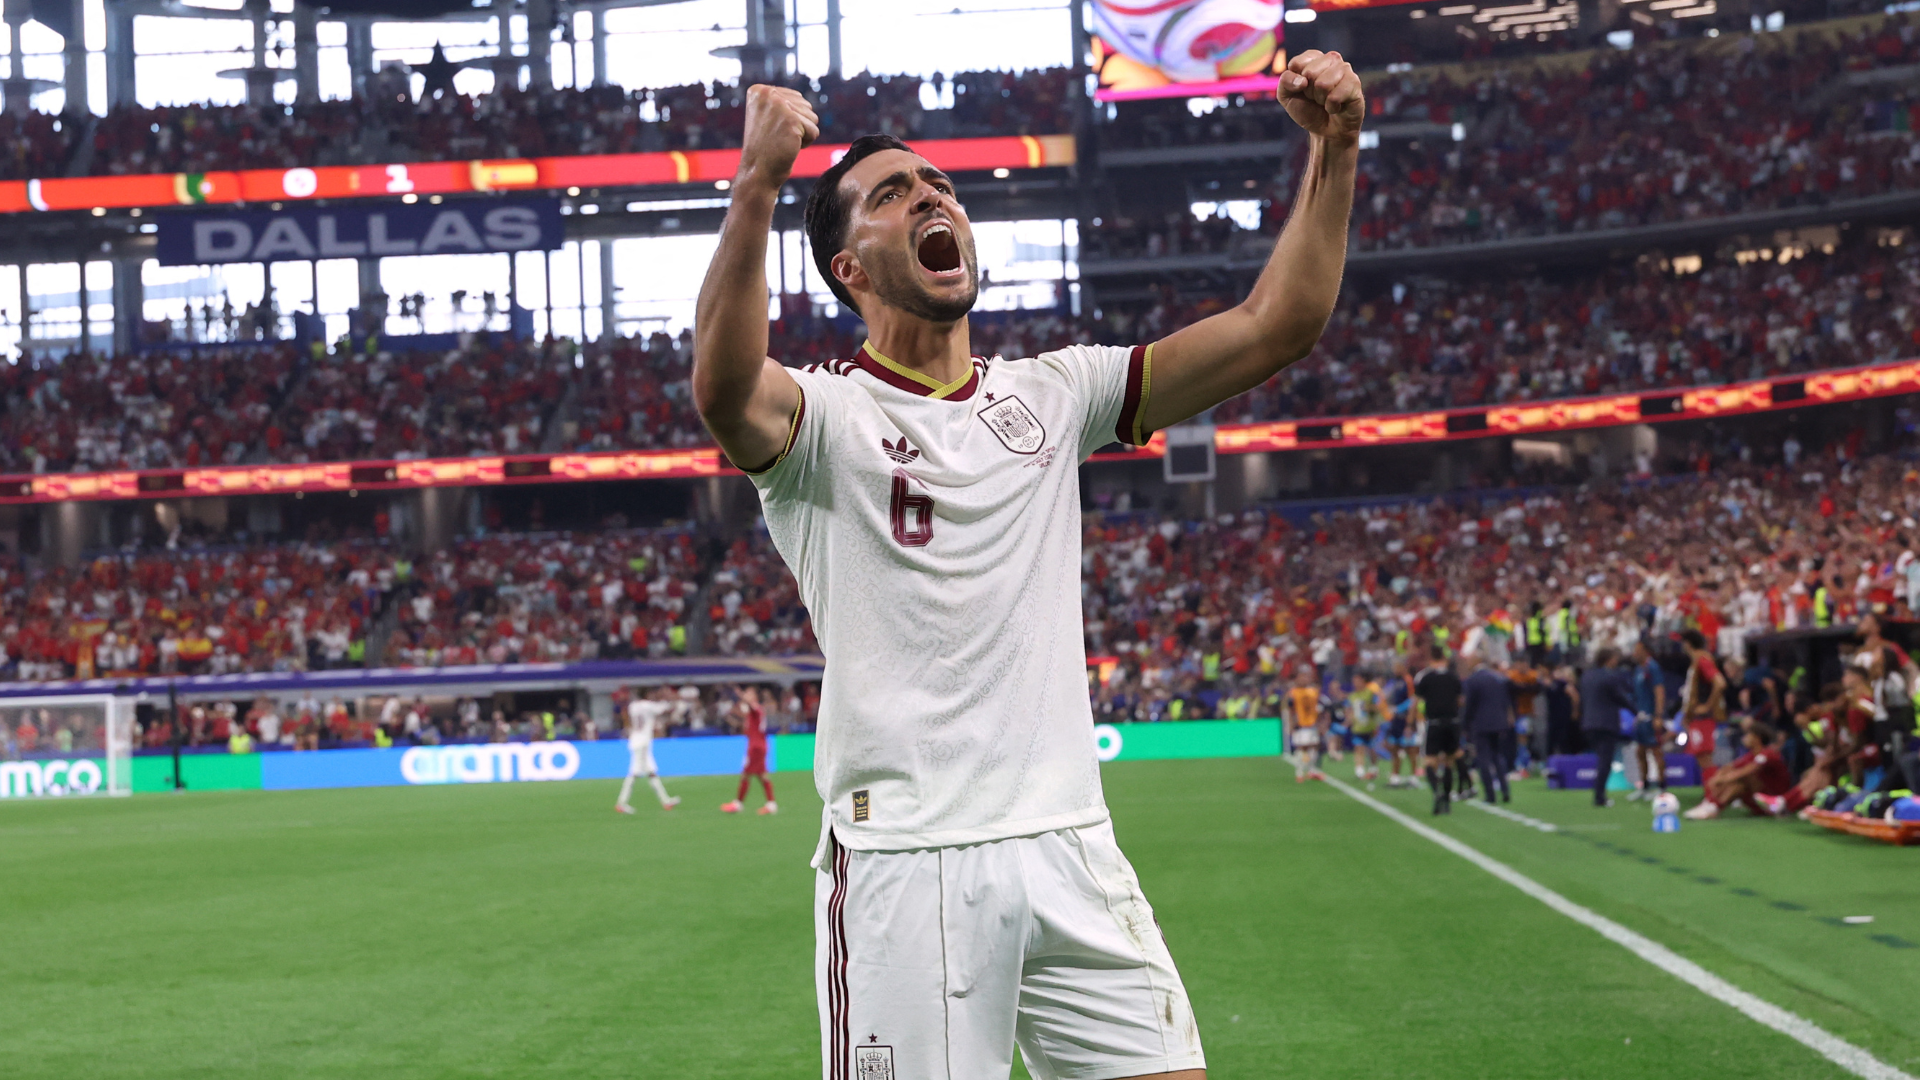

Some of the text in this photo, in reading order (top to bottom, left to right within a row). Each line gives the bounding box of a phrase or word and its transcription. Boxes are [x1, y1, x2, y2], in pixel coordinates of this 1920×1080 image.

[385, 163, 415, 193] 1
[193, 207, 541, 261] DALLAS
[889, 466, 935, 548] 6
[401, 740, 581, 785] aramco
